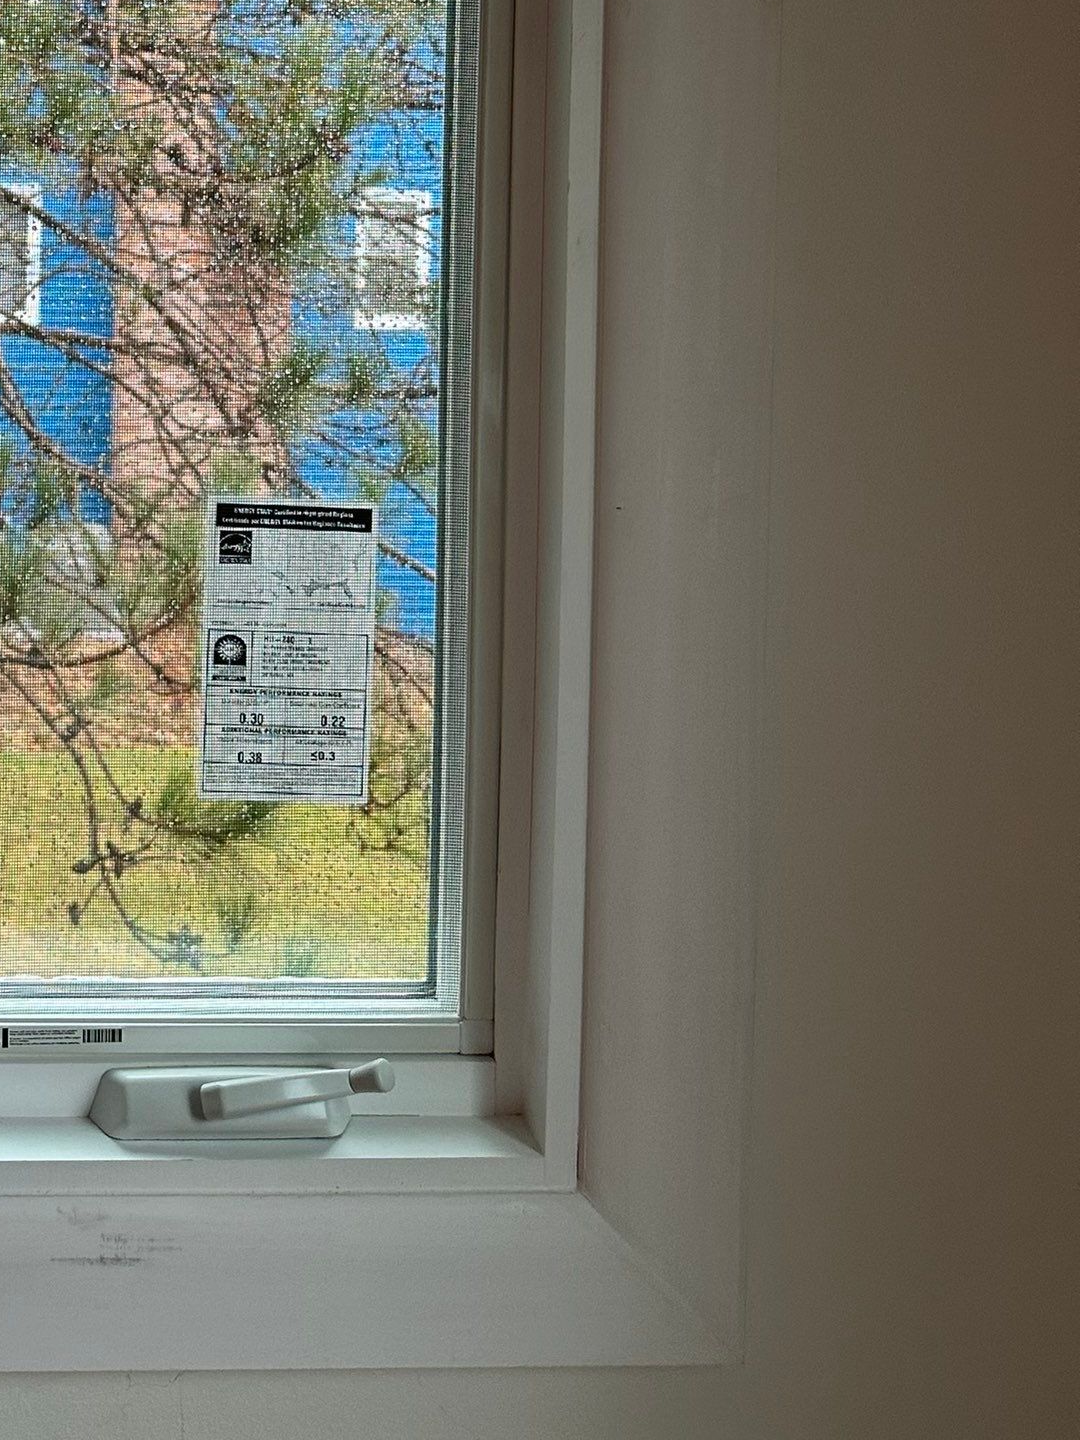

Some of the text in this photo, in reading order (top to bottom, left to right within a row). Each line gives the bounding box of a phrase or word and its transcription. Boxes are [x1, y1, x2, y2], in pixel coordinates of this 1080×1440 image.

[239, 713, 346, 728] 0.30 0.22
[237, 752, 262, 764] 0.38
